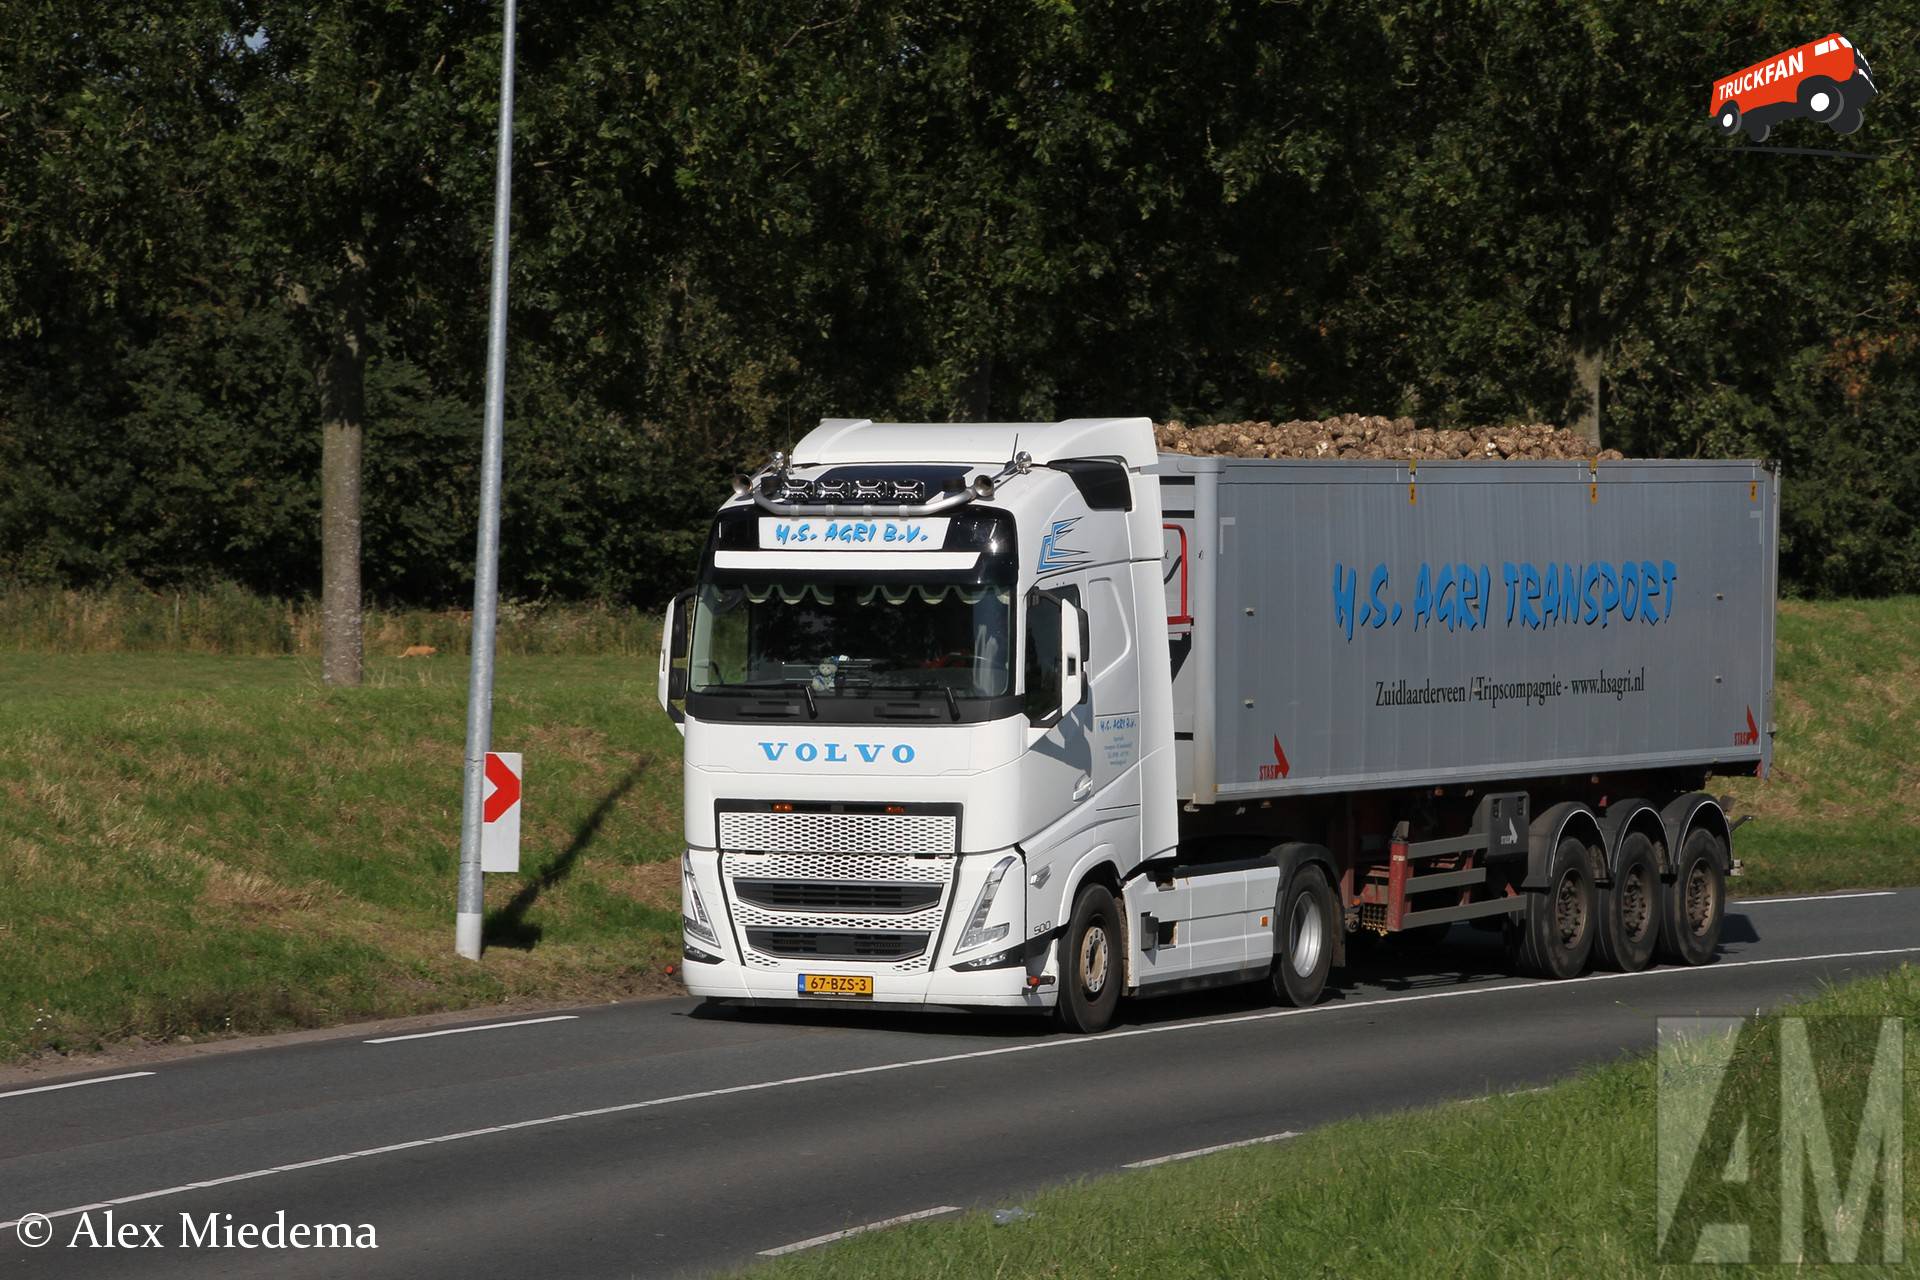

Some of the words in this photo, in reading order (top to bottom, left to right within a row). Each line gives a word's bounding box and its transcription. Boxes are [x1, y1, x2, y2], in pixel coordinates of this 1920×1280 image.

[775, 523, 817, 545] H.S.
[825, 523, 877, 543] AGRI
[883, 523, 928, 543] B.V.
[1332, 561, 1402, 644] H.S.
[1414, 561, 1491, 633] AGRI
[1503, 559, 1678, 631] TRANSPORT
[1375, 678, 1466, 706] Zuidlaarderveen
[1475, 673, 1562, 709] Tripscompagnie
[1571, 666, 1645, 701] www.hsagri.nl
[758, 742, 915, 764] VOLVO
[1033, 920, 1051, 935] 500
[810, 977, 867, 991] 67-BZS-3
